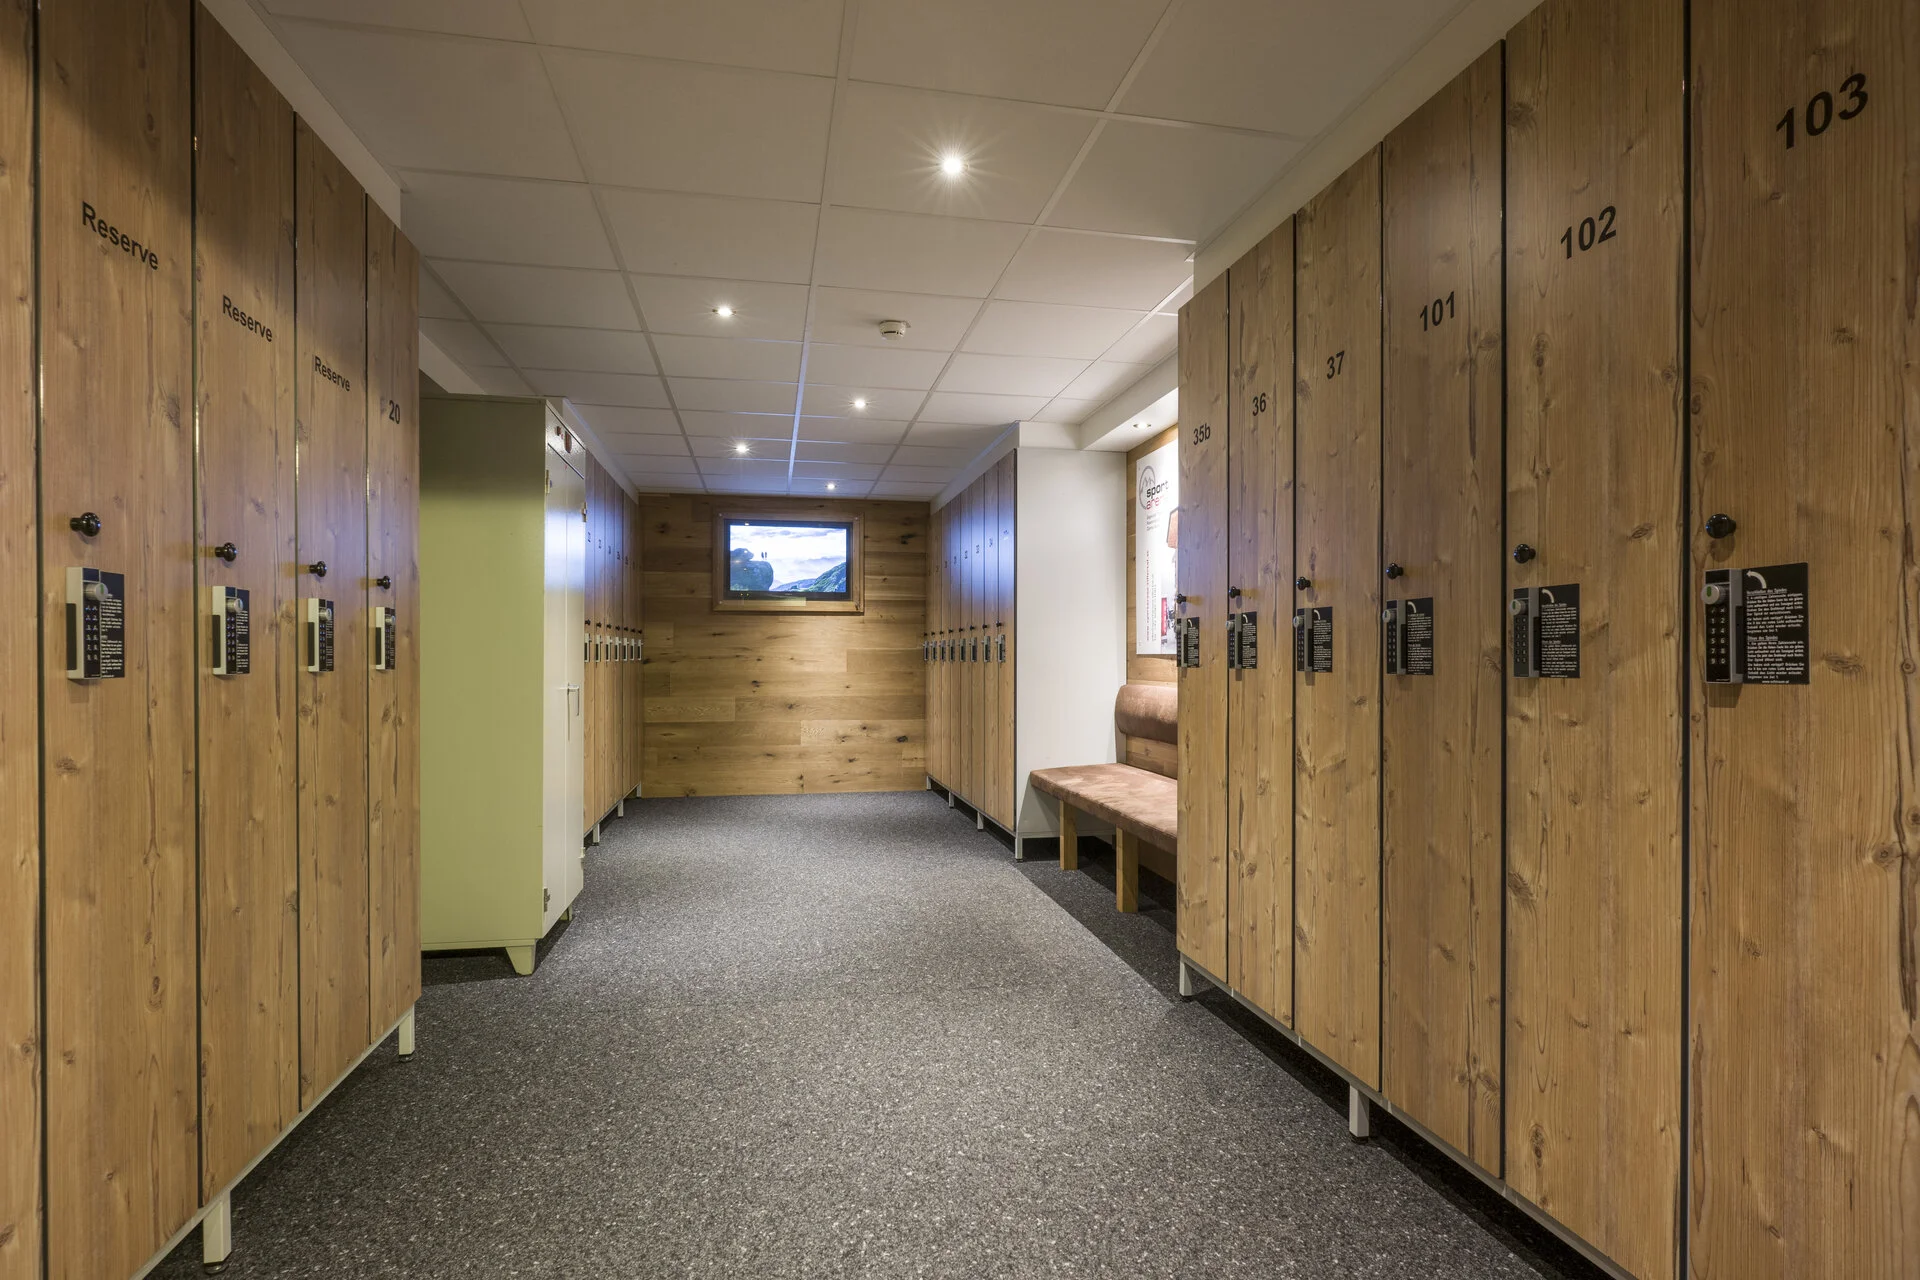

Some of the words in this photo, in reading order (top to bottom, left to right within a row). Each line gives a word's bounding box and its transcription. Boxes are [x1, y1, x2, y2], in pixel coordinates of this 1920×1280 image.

[1775, 72, 1869, 151] 103
[81, 201, 159, 271] Reserve
[1560, 204, 1618, 260] 102
[222, 294, 273, 343] Reserve
[1418, 289, 1456, 332] 101
[314, 354, 351, 392] Reserve
[1325, 349, 1346, 380] 37
[388, 399, 402, 425] 20
[1251, 391, 1268, 417] 36
[1192, 421, 1212, 446] 35b
[1146, 481, 1169, 499] sport
